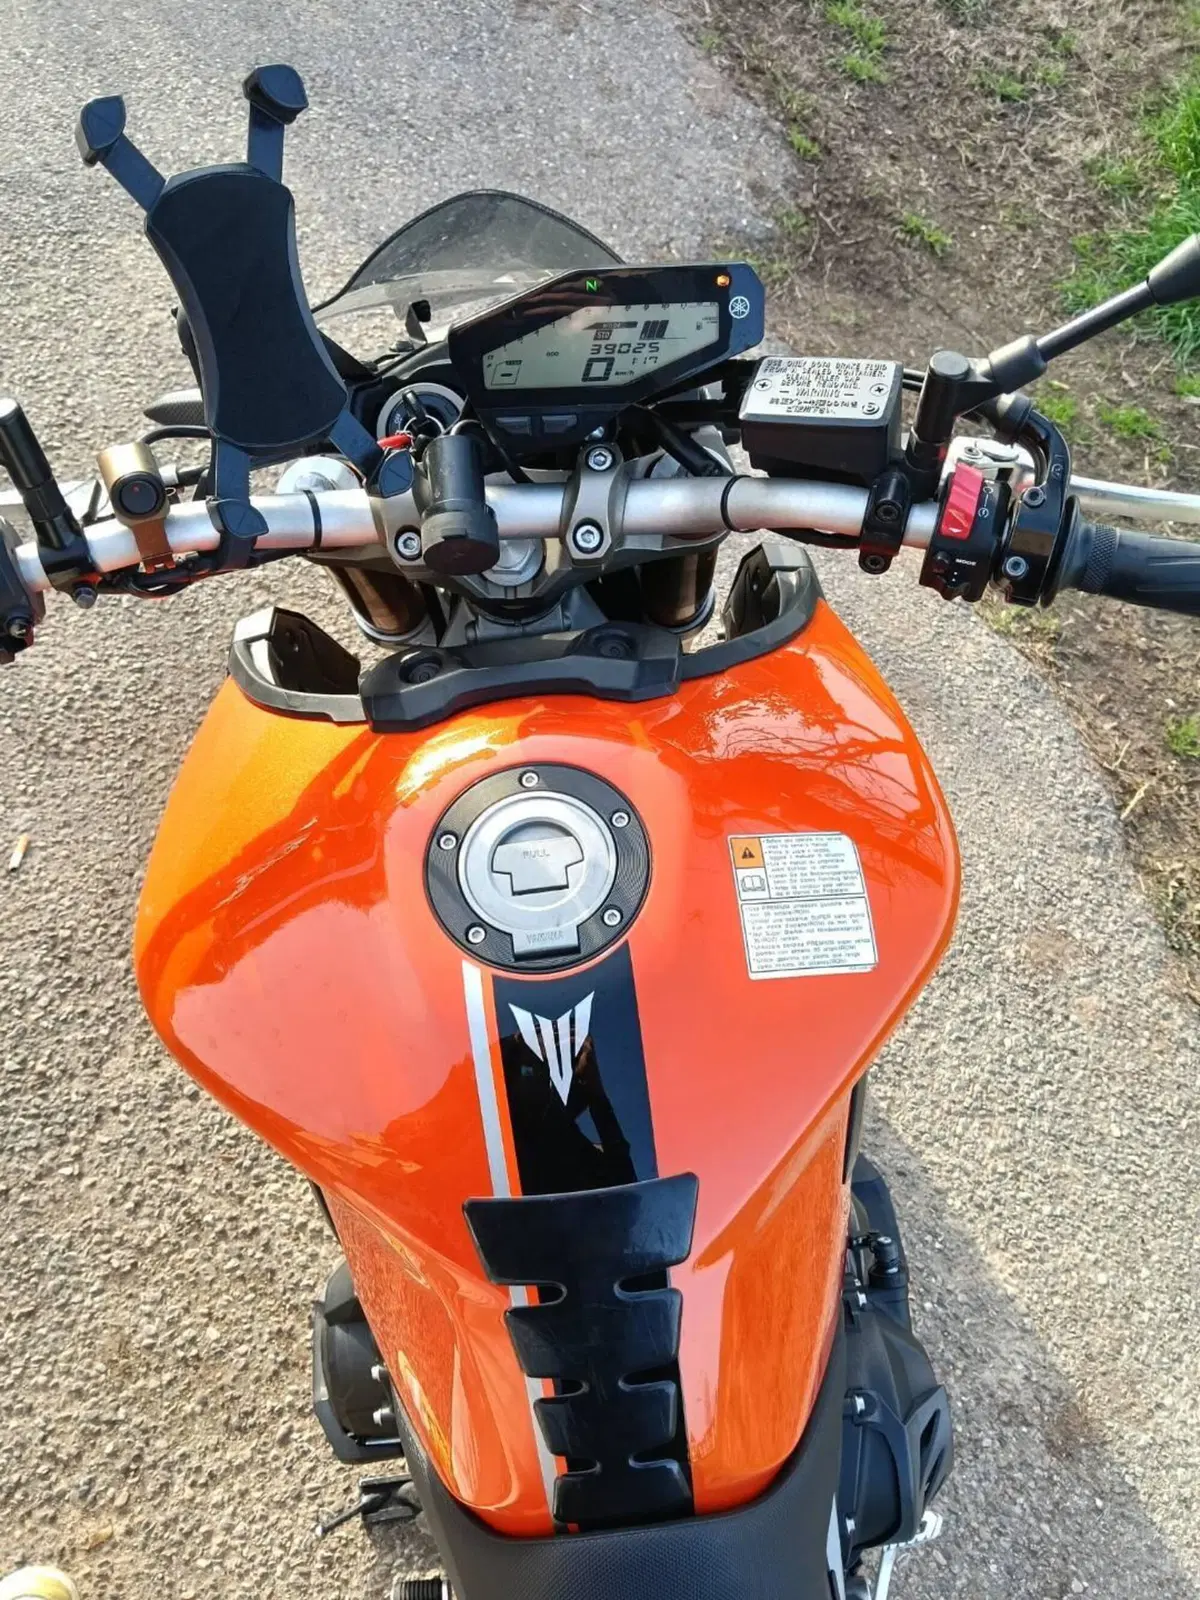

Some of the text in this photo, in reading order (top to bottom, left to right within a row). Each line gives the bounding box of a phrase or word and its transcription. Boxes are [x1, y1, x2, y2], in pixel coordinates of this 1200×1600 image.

[585, 279, 598, 292] N
[590, 341, 660, 355] 39025
[581, 356, 616, 382] 0
[522, 848, 551, 859] PULL
